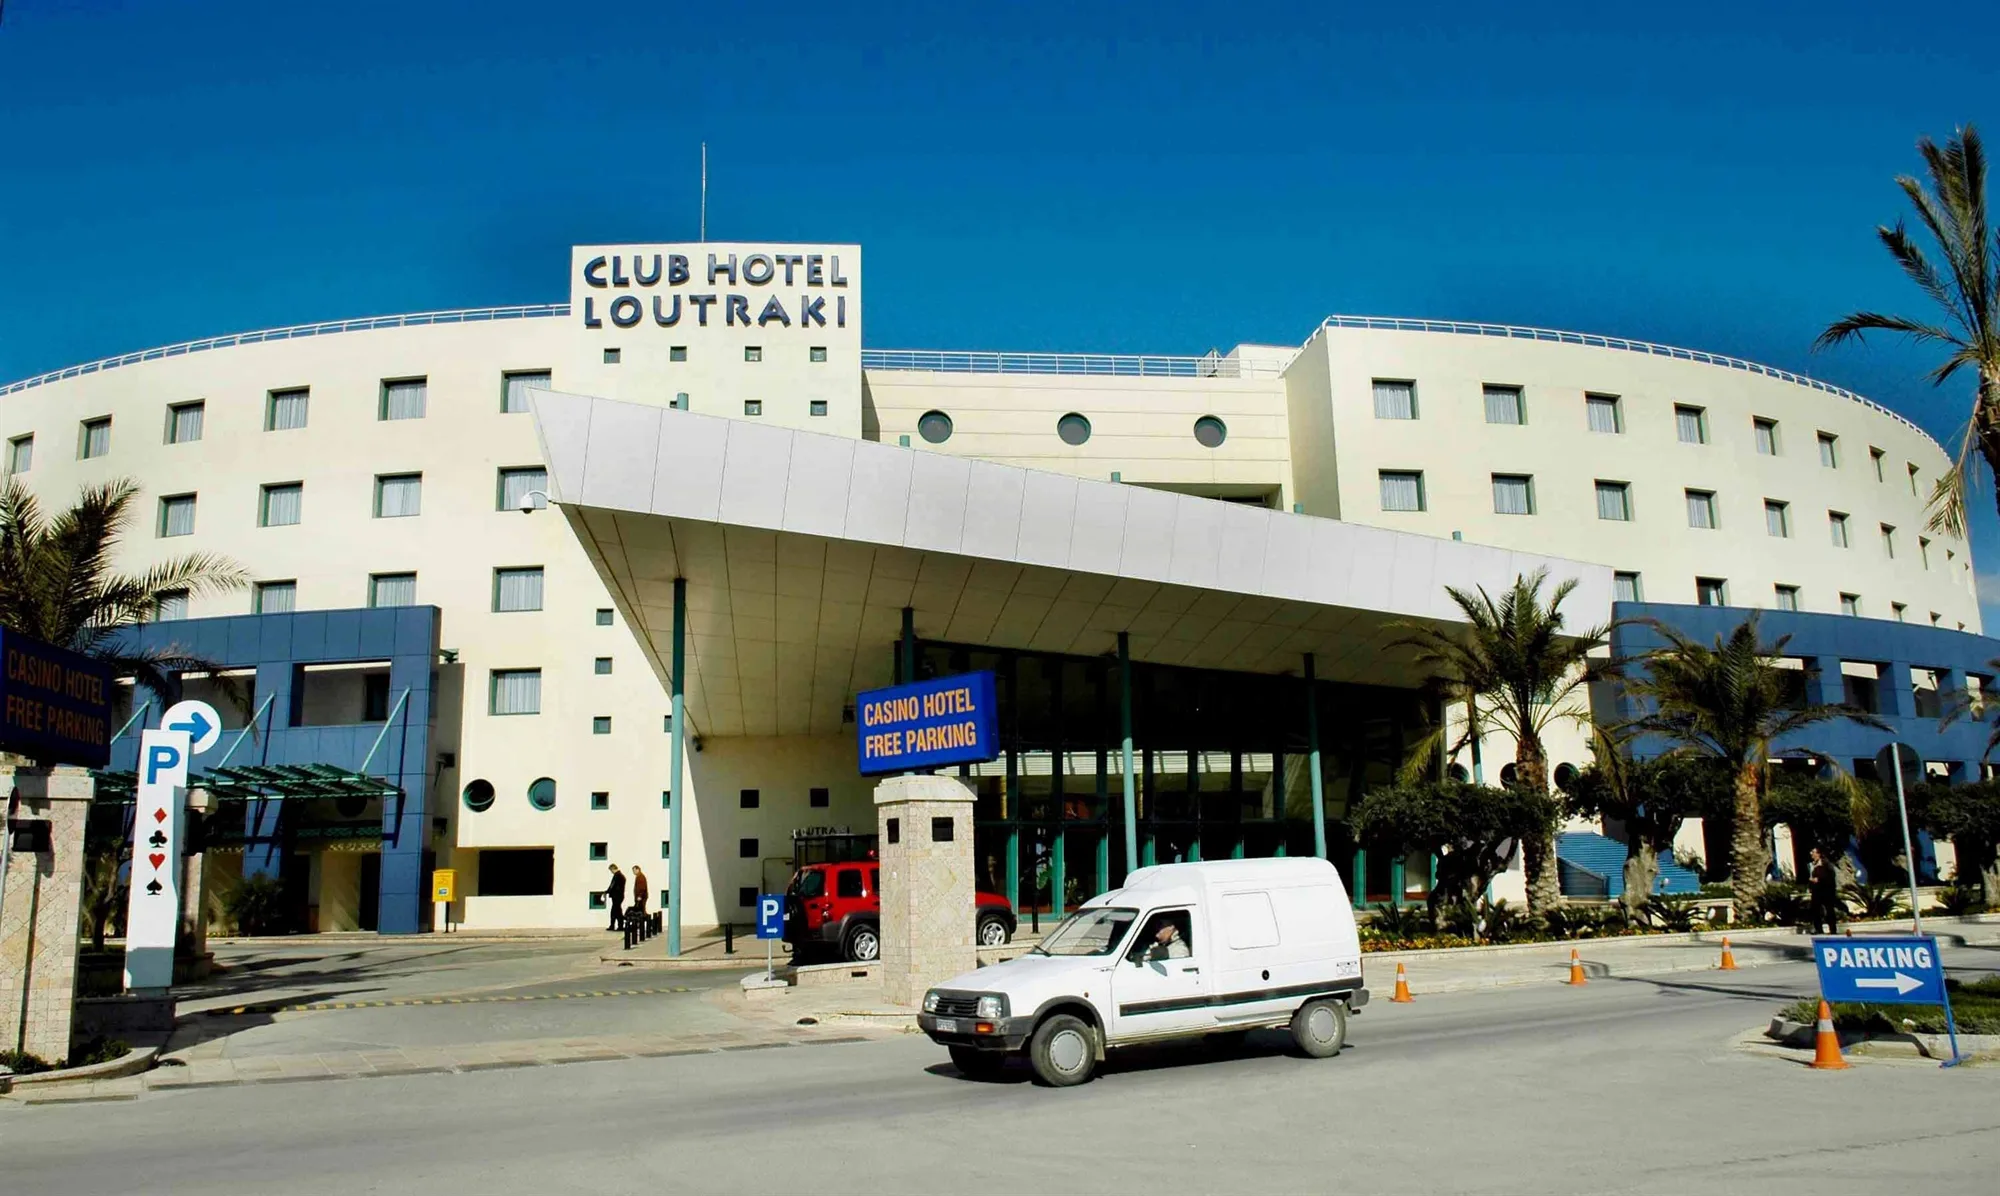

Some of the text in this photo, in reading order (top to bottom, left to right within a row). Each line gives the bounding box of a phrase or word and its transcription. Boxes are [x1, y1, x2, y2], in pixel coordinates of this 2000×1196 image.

[584, 253, 848, 288] CLUB HOTEL
[584, 294, 846, 328] LOUTRAKI
[8, 649, 106, 706] CASINO HOTEL
[6, 694, 105, 746] FREE PARKING
[864, 687, 976, 727] CASINO HOTEL
[865, 721, 977, 759] FREE PARKING
[147, 746, 180, 785] P
[762, 899, 779, 926] P
[1823, 946, 1932, 968] PARKING
